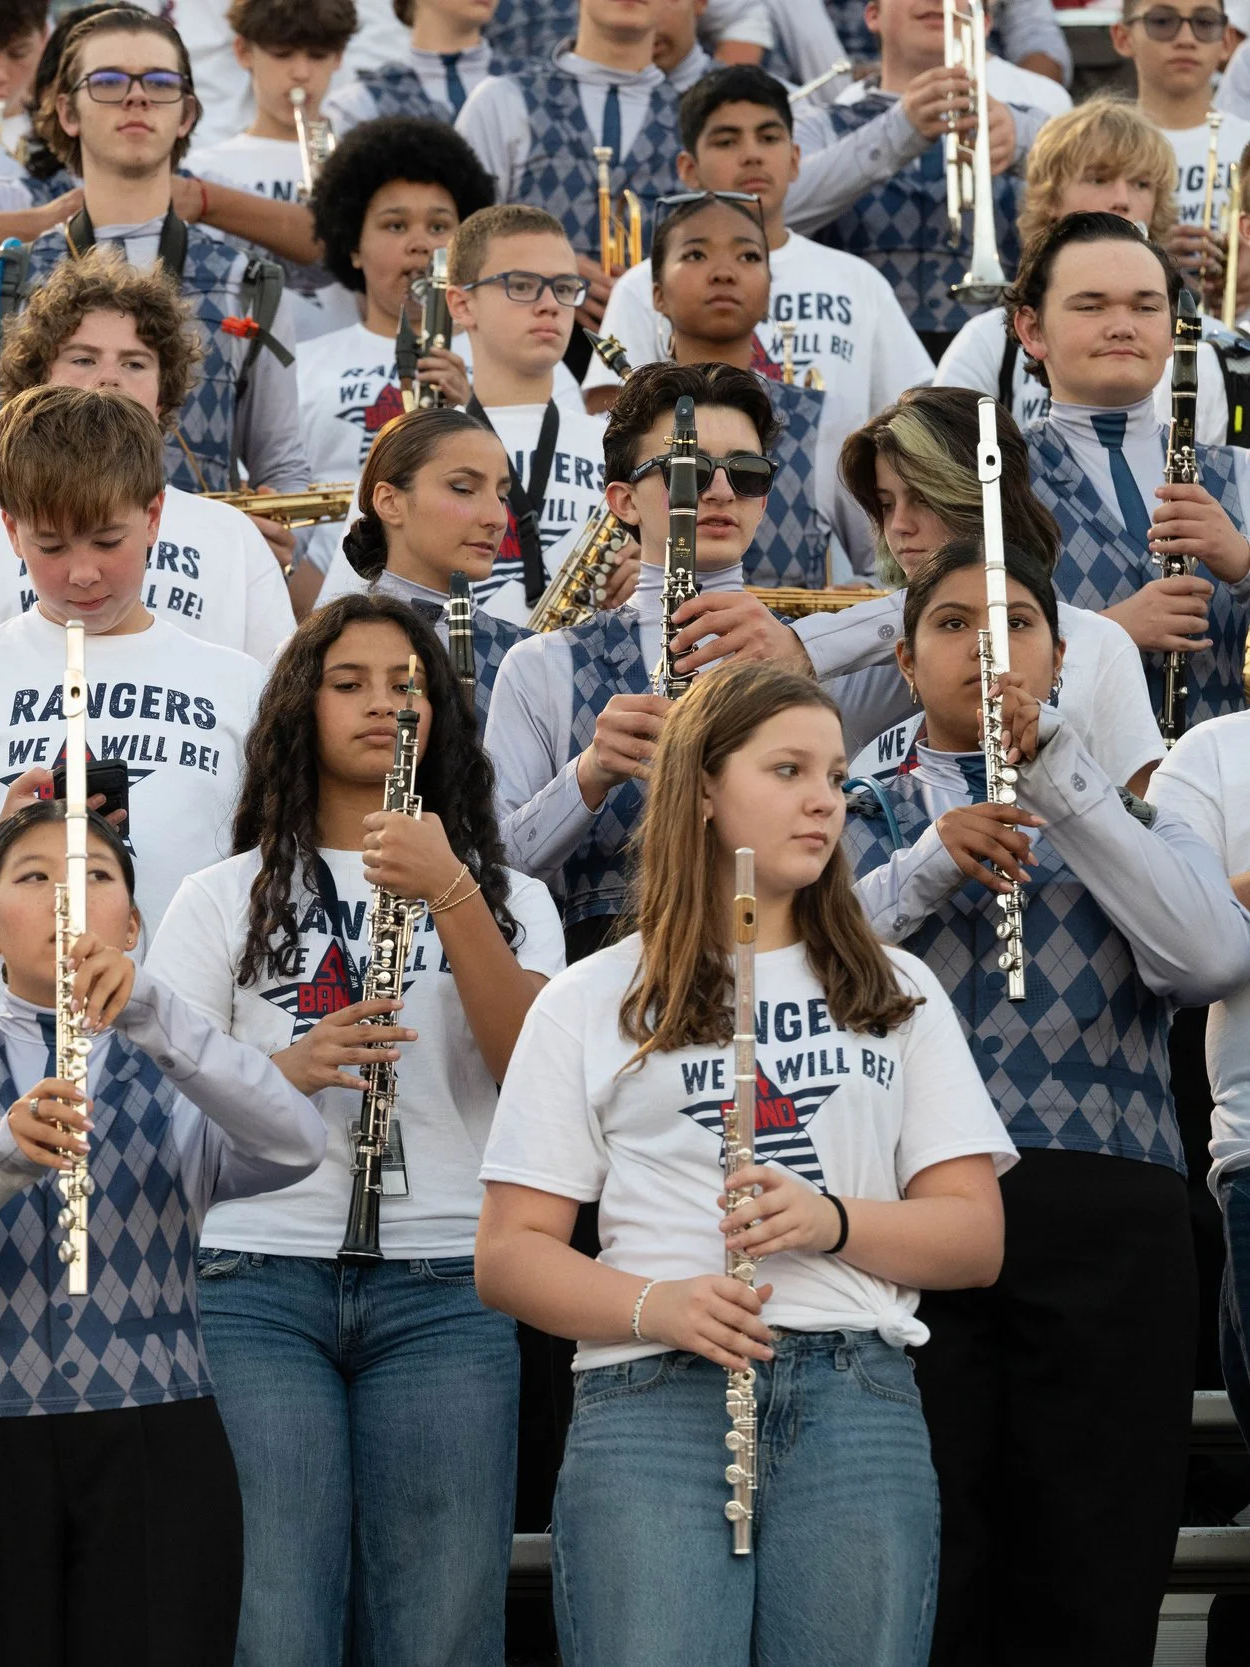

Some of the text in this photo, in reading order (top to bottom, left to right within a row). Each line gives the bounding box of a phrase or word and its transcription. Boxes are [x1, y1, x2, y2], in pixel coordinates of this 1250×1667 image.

[762, 292, 852, 325] GERS
[340, 383, 369, 404] WE
[142, 584, 203, 620] L BE!
[9, 682, 217, 730] RANGERS
[9, 735, 220, 776] WE WILL BE!
[878, 727, 906, 763] WE
[755, 998, 887, 1045] NGE
[681, 1047, 895, 1095] WE WILL BE!
